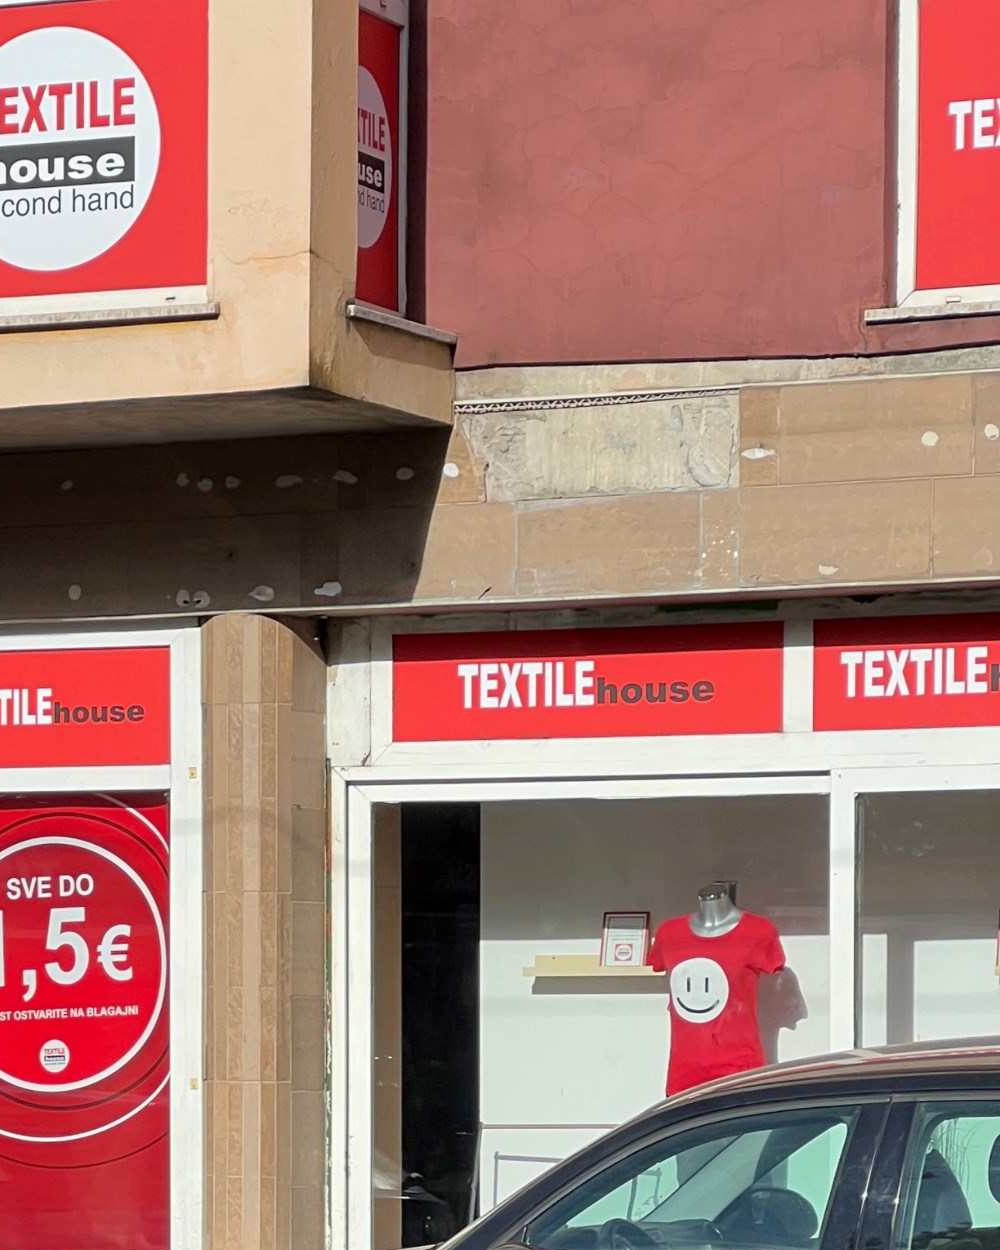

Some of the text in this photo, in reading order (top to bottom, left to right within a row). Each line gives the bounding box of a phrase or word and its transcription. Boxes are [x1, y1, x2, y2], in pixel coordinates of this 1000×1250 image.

[358, 107, 385, 152] TILE
[948, 98, 1000, 150] TE
[358, 161, 383, 188] use
[71, 184, 135, 212] hand
[6, 873, 94, 900] SVE DO
[13, 1008, 67, 1021] OSTVARITE
[70, 1007, 85, 1017] NA
[86, 1005, 139, 1017] BLAGAJNI
